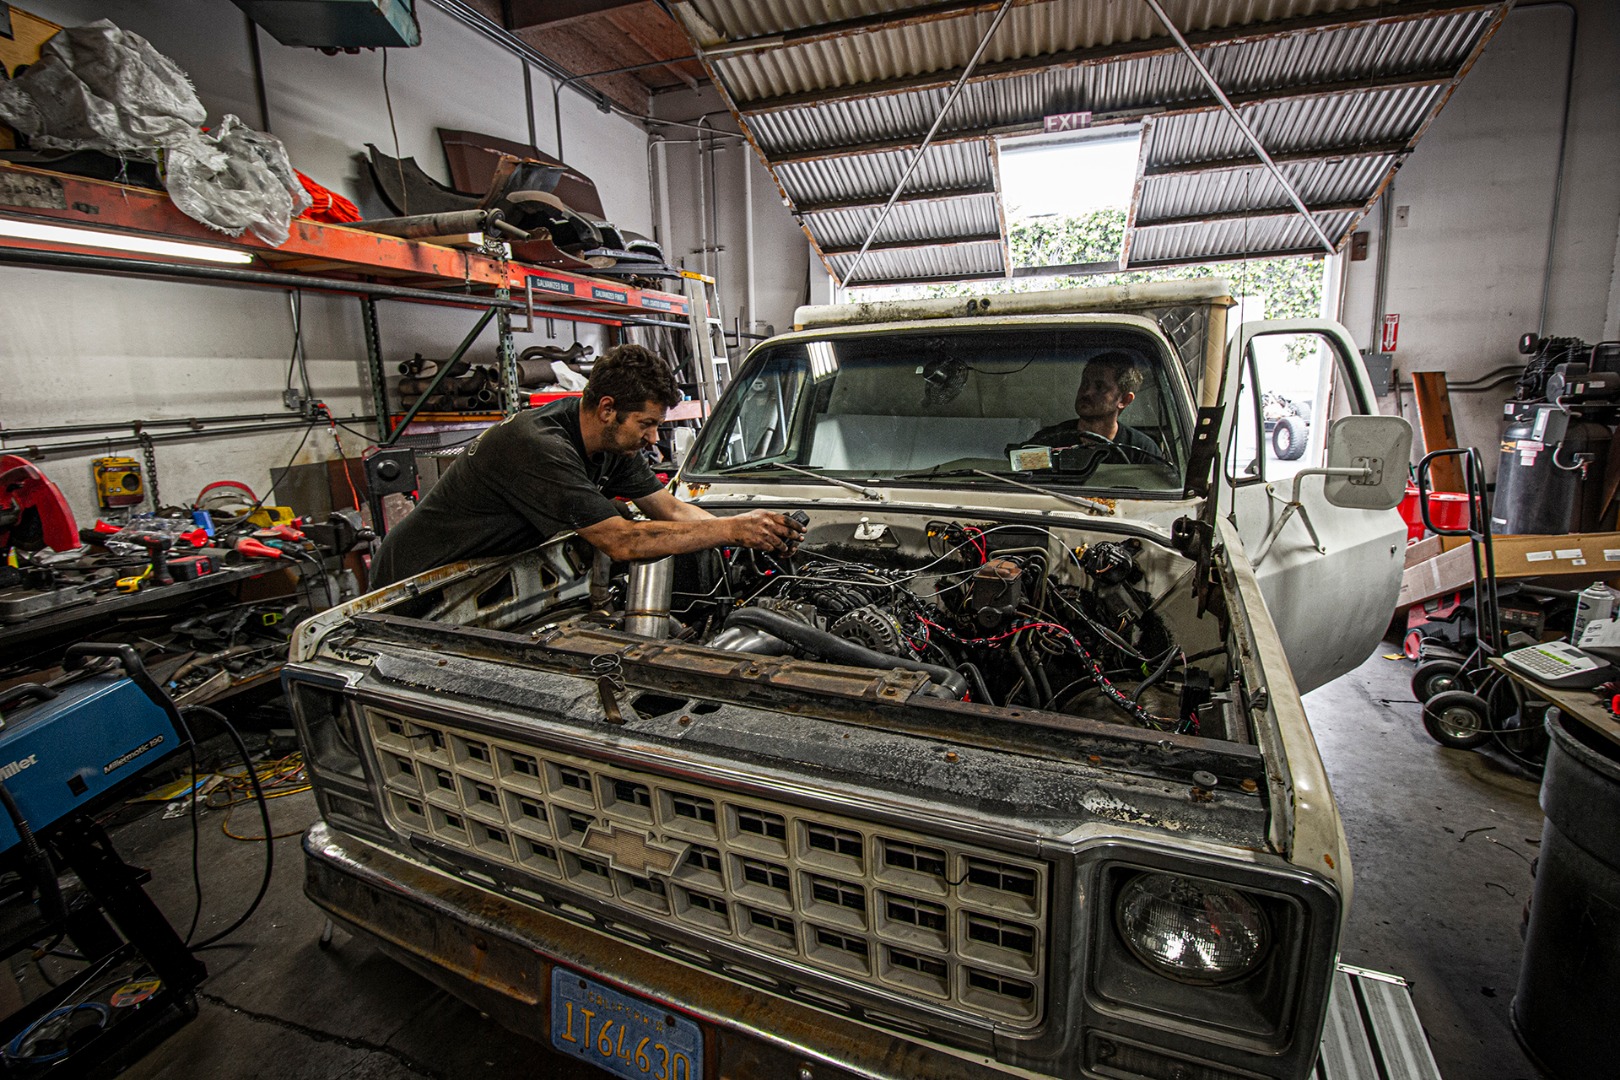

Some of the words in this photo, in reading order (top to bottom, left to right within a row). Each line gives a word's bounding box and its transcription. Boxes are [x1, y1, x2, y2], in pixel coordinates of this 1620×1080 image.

[1048, 112, 1091, 131] EXIT
[104, 743, 149, 775] Millermatic
[149, 734, 164, 748] 190
[587, 991, 663, 1031] CALIFORNIA
